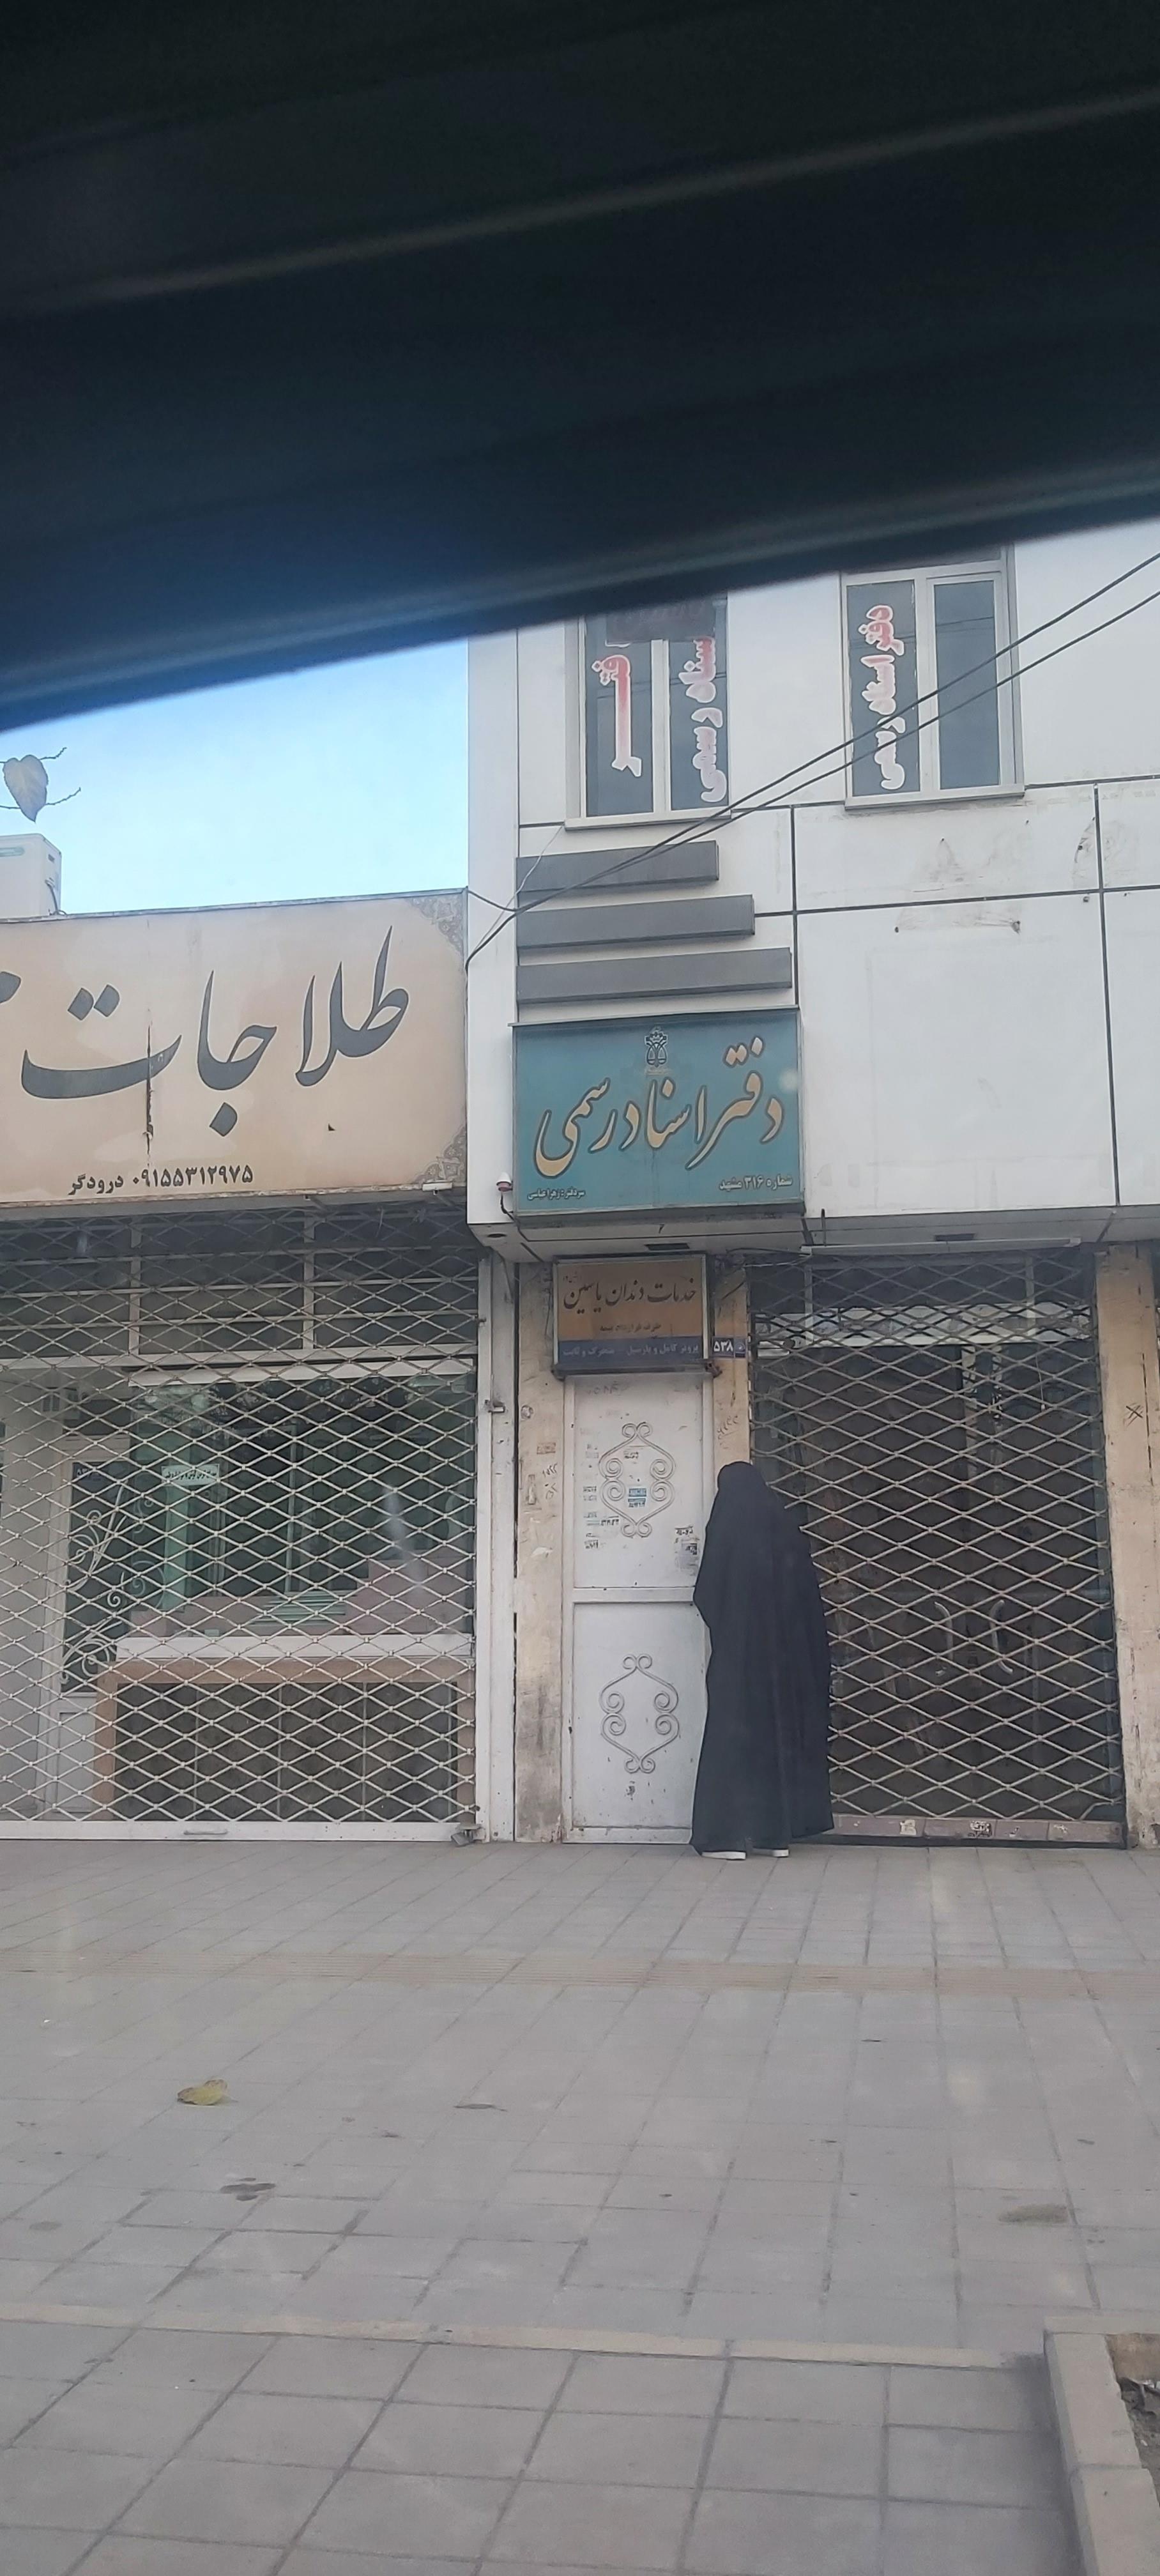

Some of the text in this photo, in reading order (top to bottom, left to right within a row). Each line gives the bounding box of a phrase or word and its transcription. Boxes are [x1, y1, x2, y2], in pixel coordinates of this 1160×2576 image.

[591, 654, 642, 778] فتر
[678, 637, 727, 802] سناد رسمی
[857, 604, 906, 790] دفتر اسناد رسمی
[534, 1036, 784, 1179] دفتر اسناد رسمی
[68, 1165, 254, 1195] ۰۹۱۵۵۳۱۲۹۷۵ درودگر
[719, 1177, 742, 1192] مشهد
[766, 1173, 793, 1191] شماره
[563, 1277, 697, 1315] خدمات دندان یاسین
